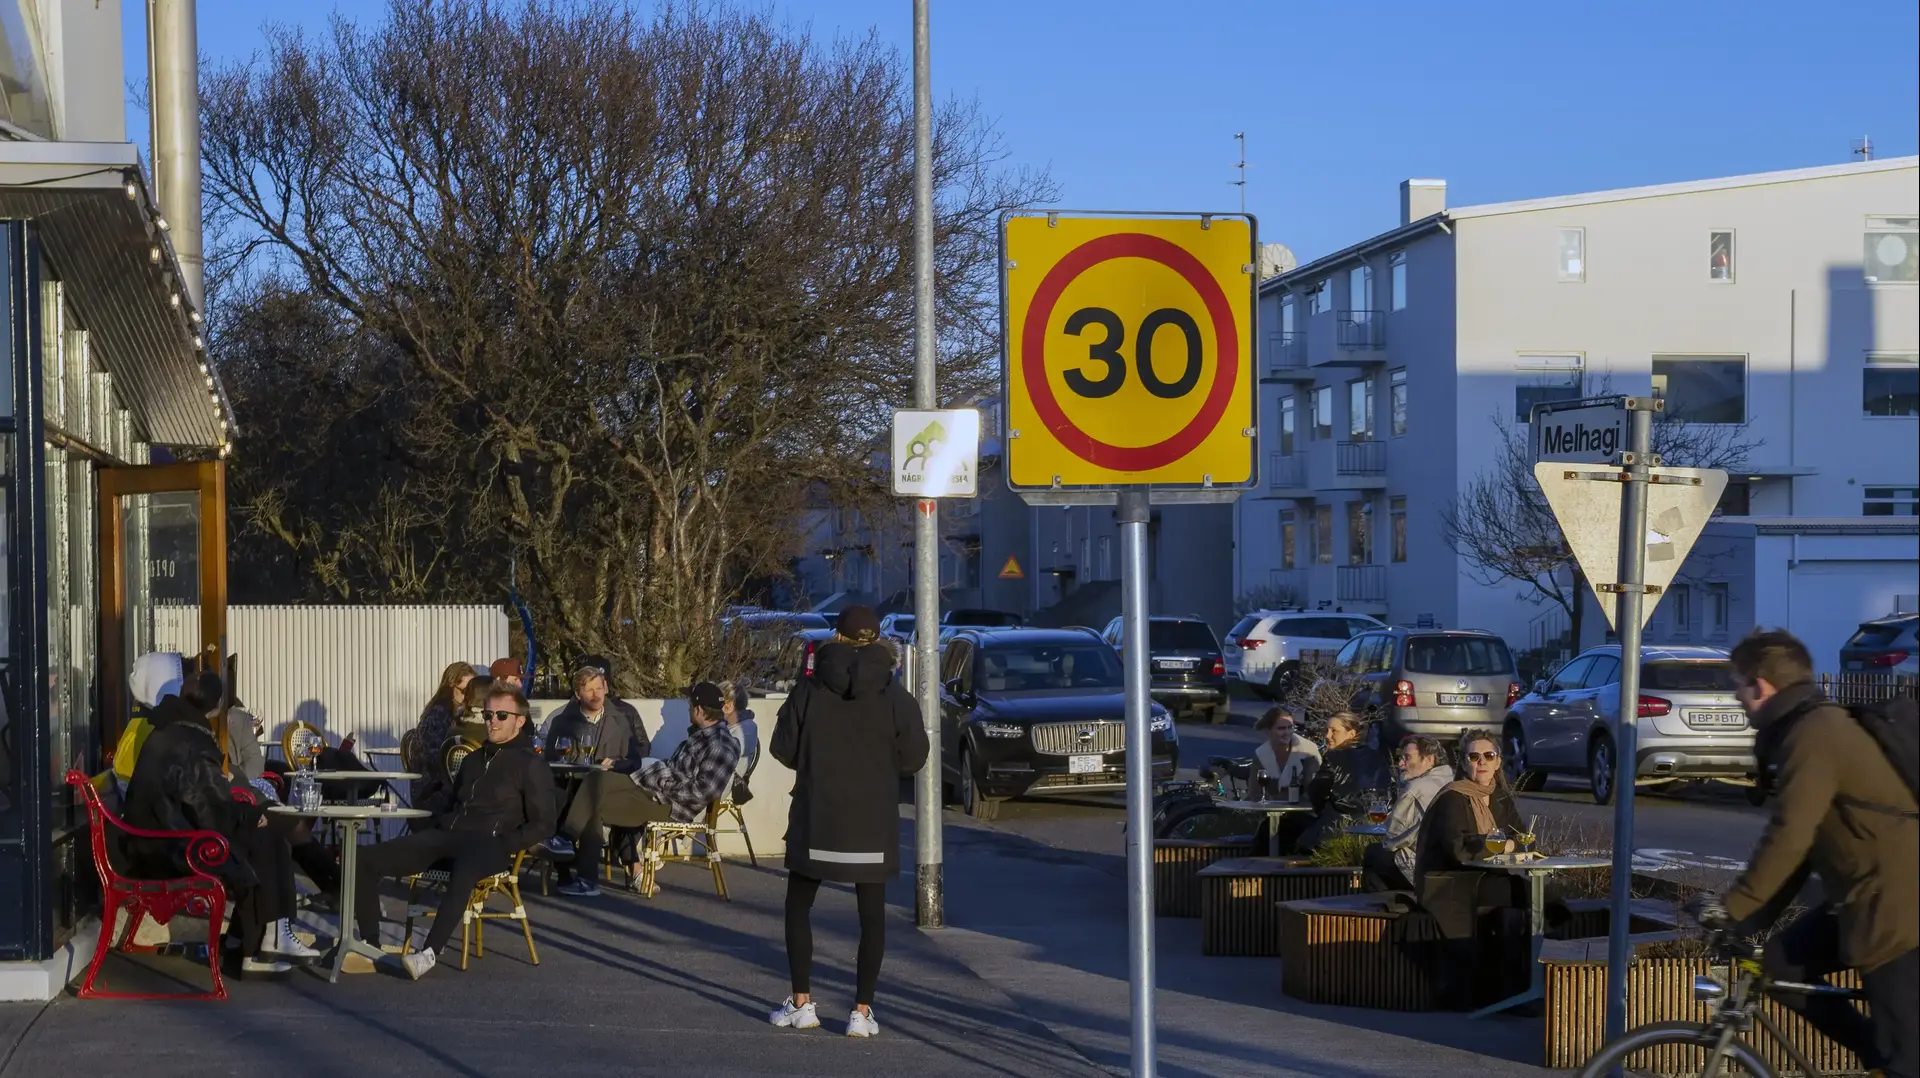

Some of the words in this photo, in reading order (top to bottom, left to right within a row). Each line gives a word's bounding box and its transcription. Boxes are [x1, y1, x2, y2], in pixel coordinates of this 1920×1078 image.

[1062, 306, 1203, 399] 30
[1544, 420, 1620, 457] Melhagi
[1447, 695, 1458, 703] JY
[1465, 695, 1482, 703] D47
[1698, 713, 1713, 723] BP
[1721, 714, 1739, 723] B17
